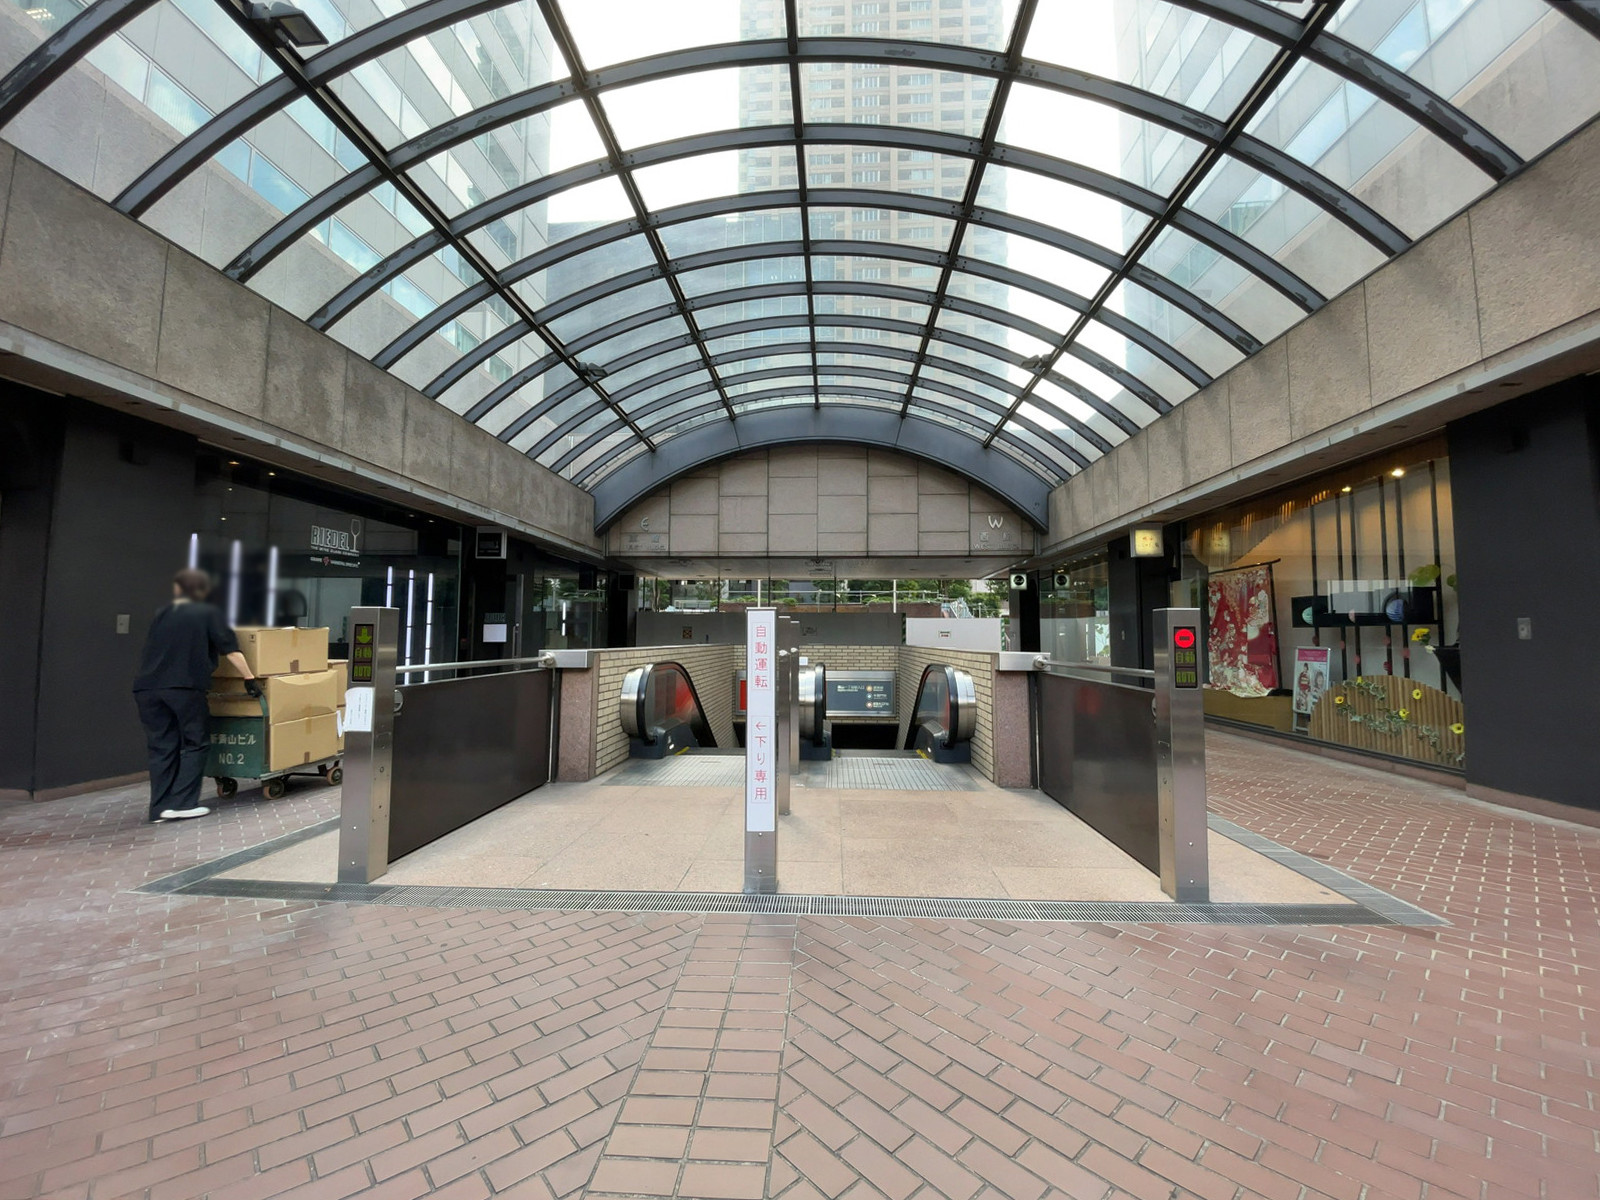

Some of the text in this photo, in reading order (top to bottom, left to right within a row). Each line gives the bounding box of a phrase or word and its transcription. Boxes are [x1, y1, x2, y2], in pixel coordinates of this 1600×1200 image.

[987, 515, 1004, 529] W
[311, 525, 350, 551] RIEDEL
[754, 625, 768, 688] 自動運転
[353, 665, 372, 678] AUTO
[1175, 671, 1196, 684] AUTO
[754, 735, 768, 800] 下り専用
